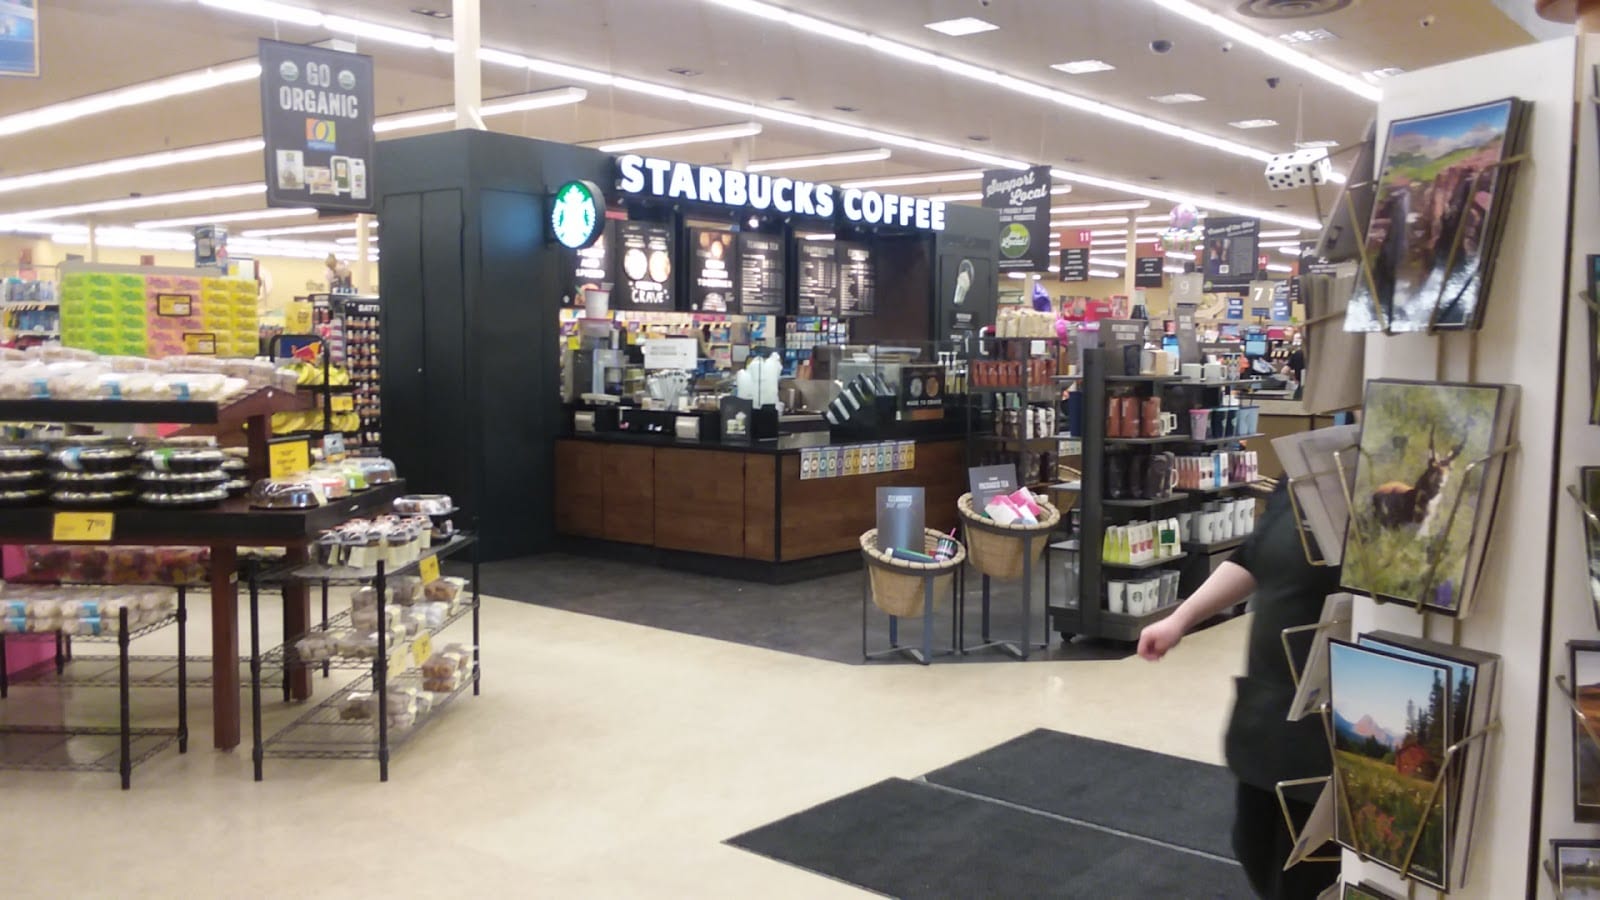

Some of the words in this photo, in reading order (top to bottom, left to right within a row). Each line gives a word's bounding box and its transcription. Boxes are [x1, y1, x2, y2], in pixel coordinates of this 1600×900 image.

[306, 62, 331, 88] GO
[279, 86, 358, 118] ORGANIC
[619, 154, 834, 218] STARBUCKS
[843, 187, 946, 231] COFFEE
[986, 171, 1035, 198] Support
[1009, 184, 1048, 206] Local
[1079, 232, 1089, 242] 11
[631, 289, 664, 304] CRAVE
[1254, 287, 1263, 301] 7
